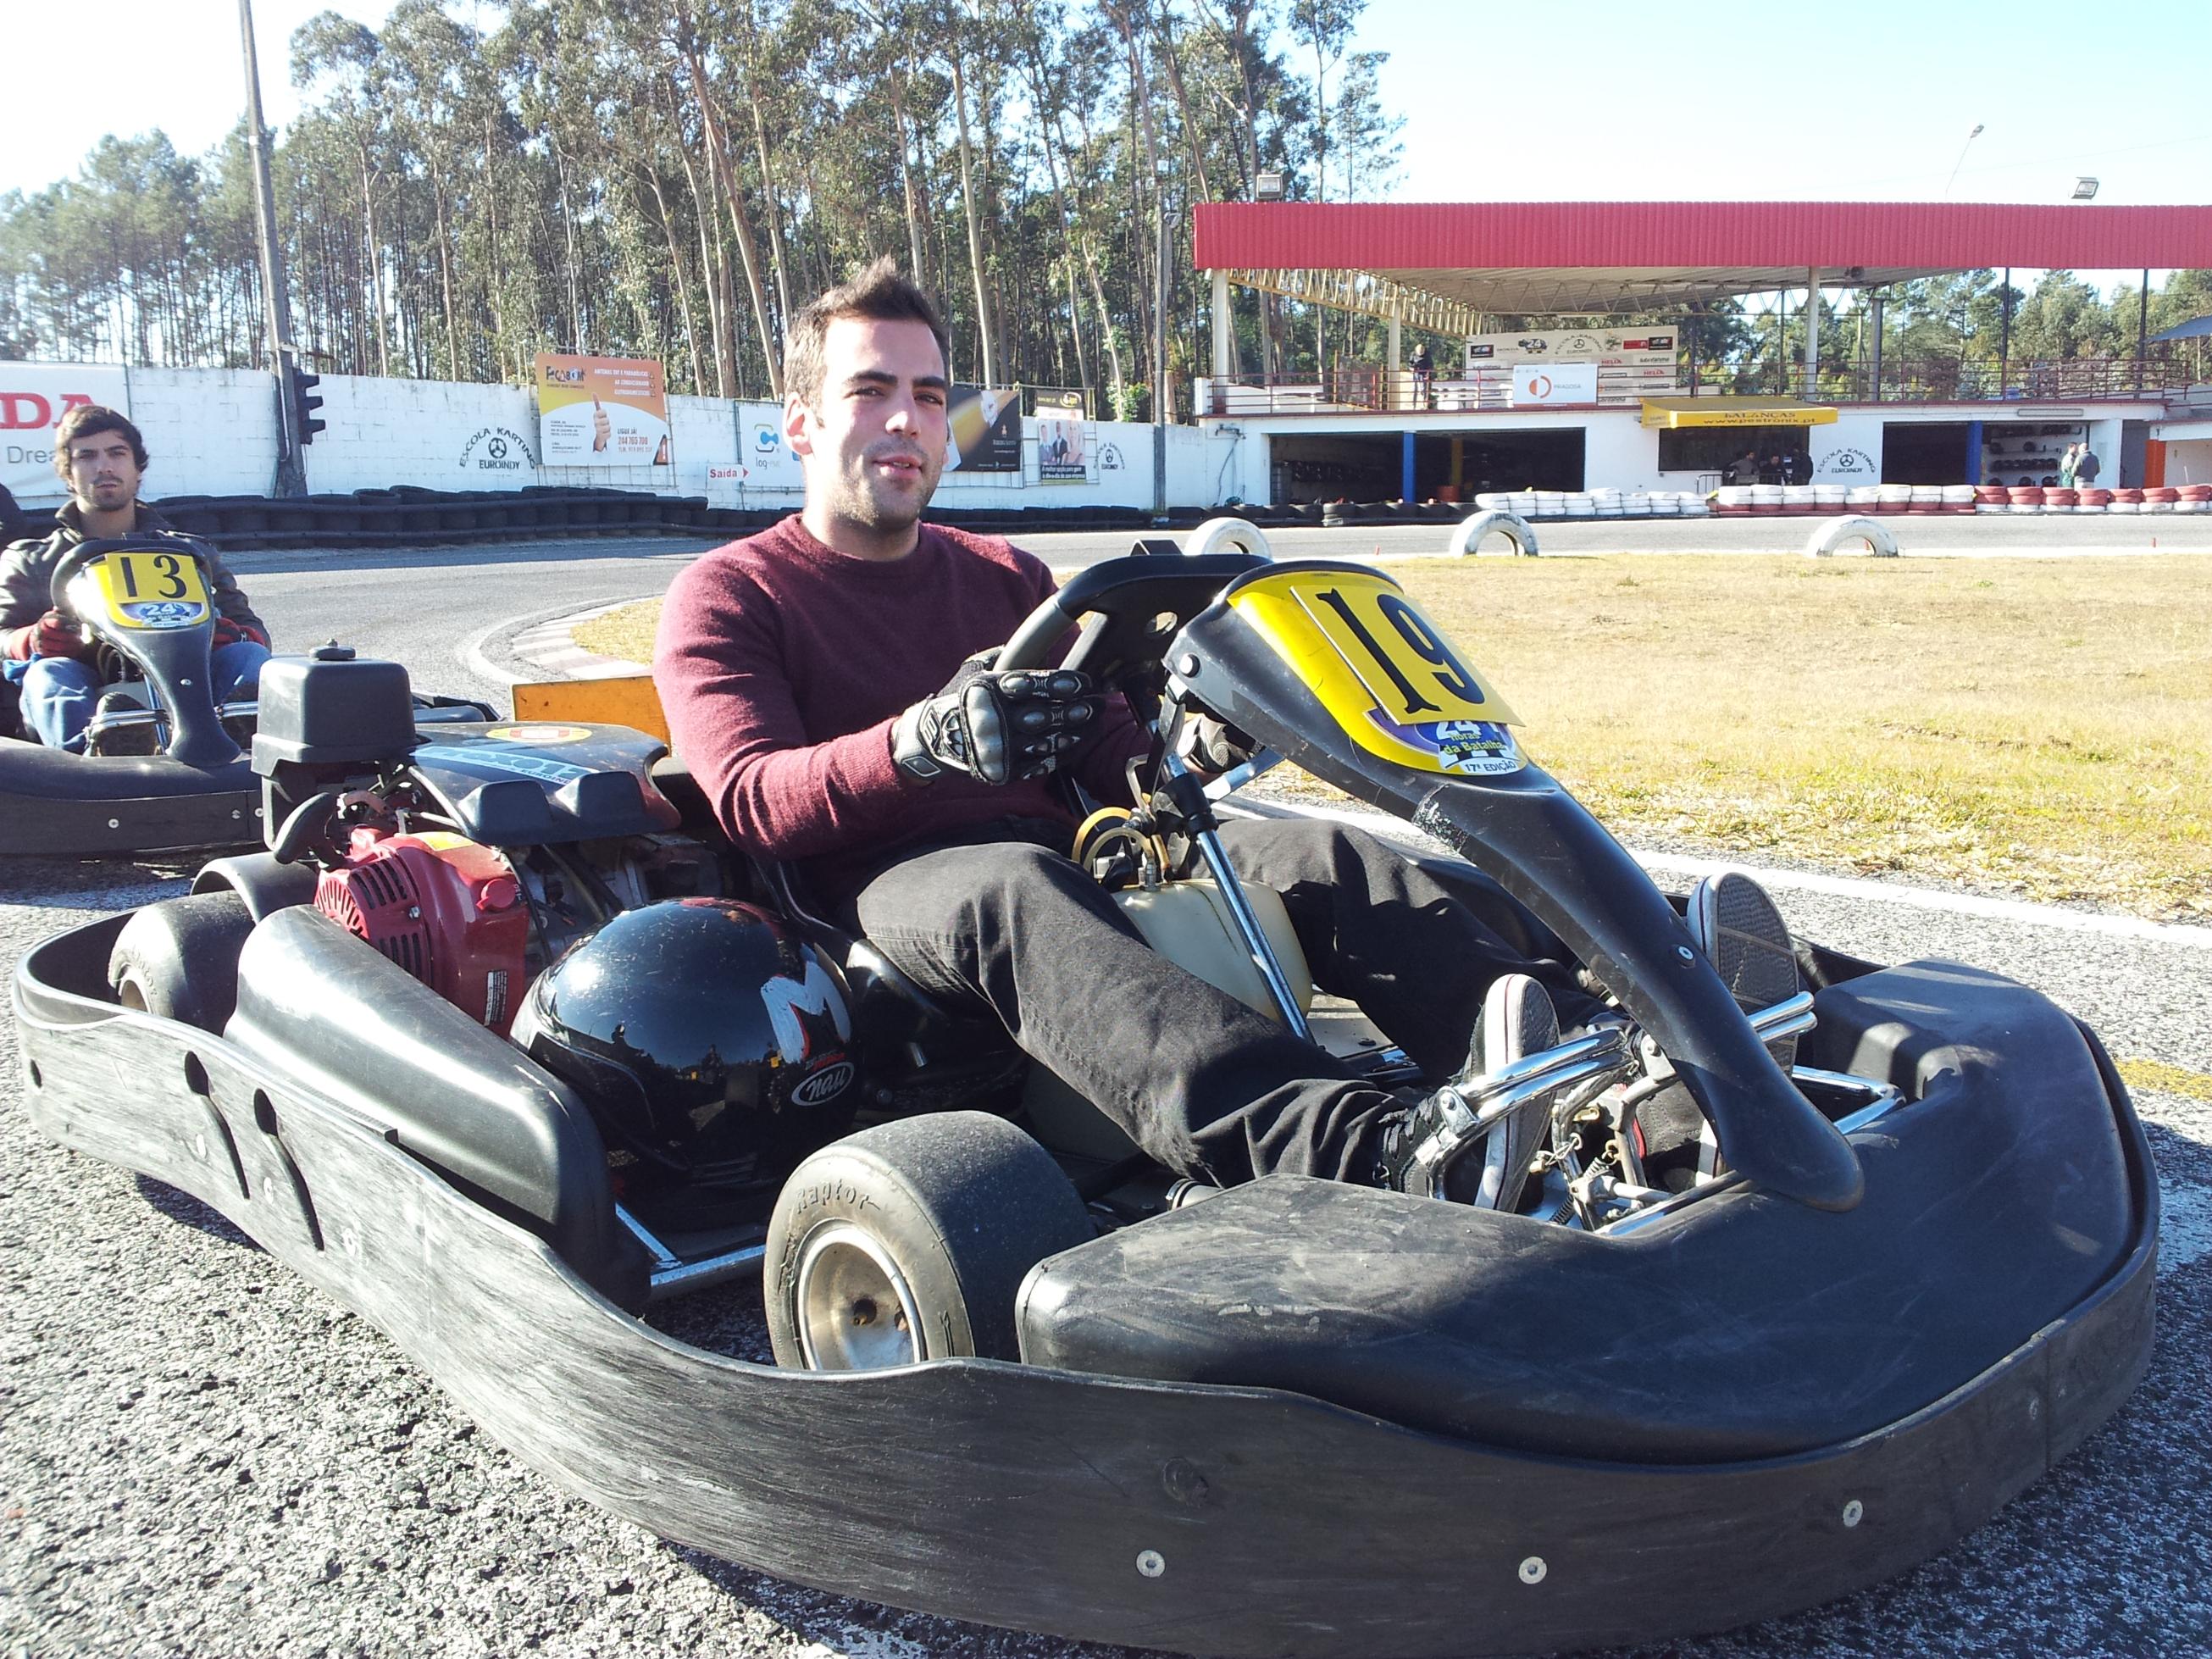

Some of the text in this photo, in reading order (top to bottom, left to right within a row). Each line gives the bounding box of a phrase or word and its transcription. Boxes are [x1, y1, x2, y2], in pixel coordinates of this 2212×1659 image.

[458, 427, 536, 470] ESCOLA KARTING
[479, 459, 520, 469] EUROINDY
[1816, 447, 1876, 473] ESCOLA KARTING
[119, 555, 187, 598] 13
[144, 602, 177, 615] 24
[1315, 587, 1485, 715] 19
[1444, 740, 1505, 755] da Batalha
[1483, 760, 1516, 772] EDIÇÃO
[521, 768, 572, 785] EUROIND
